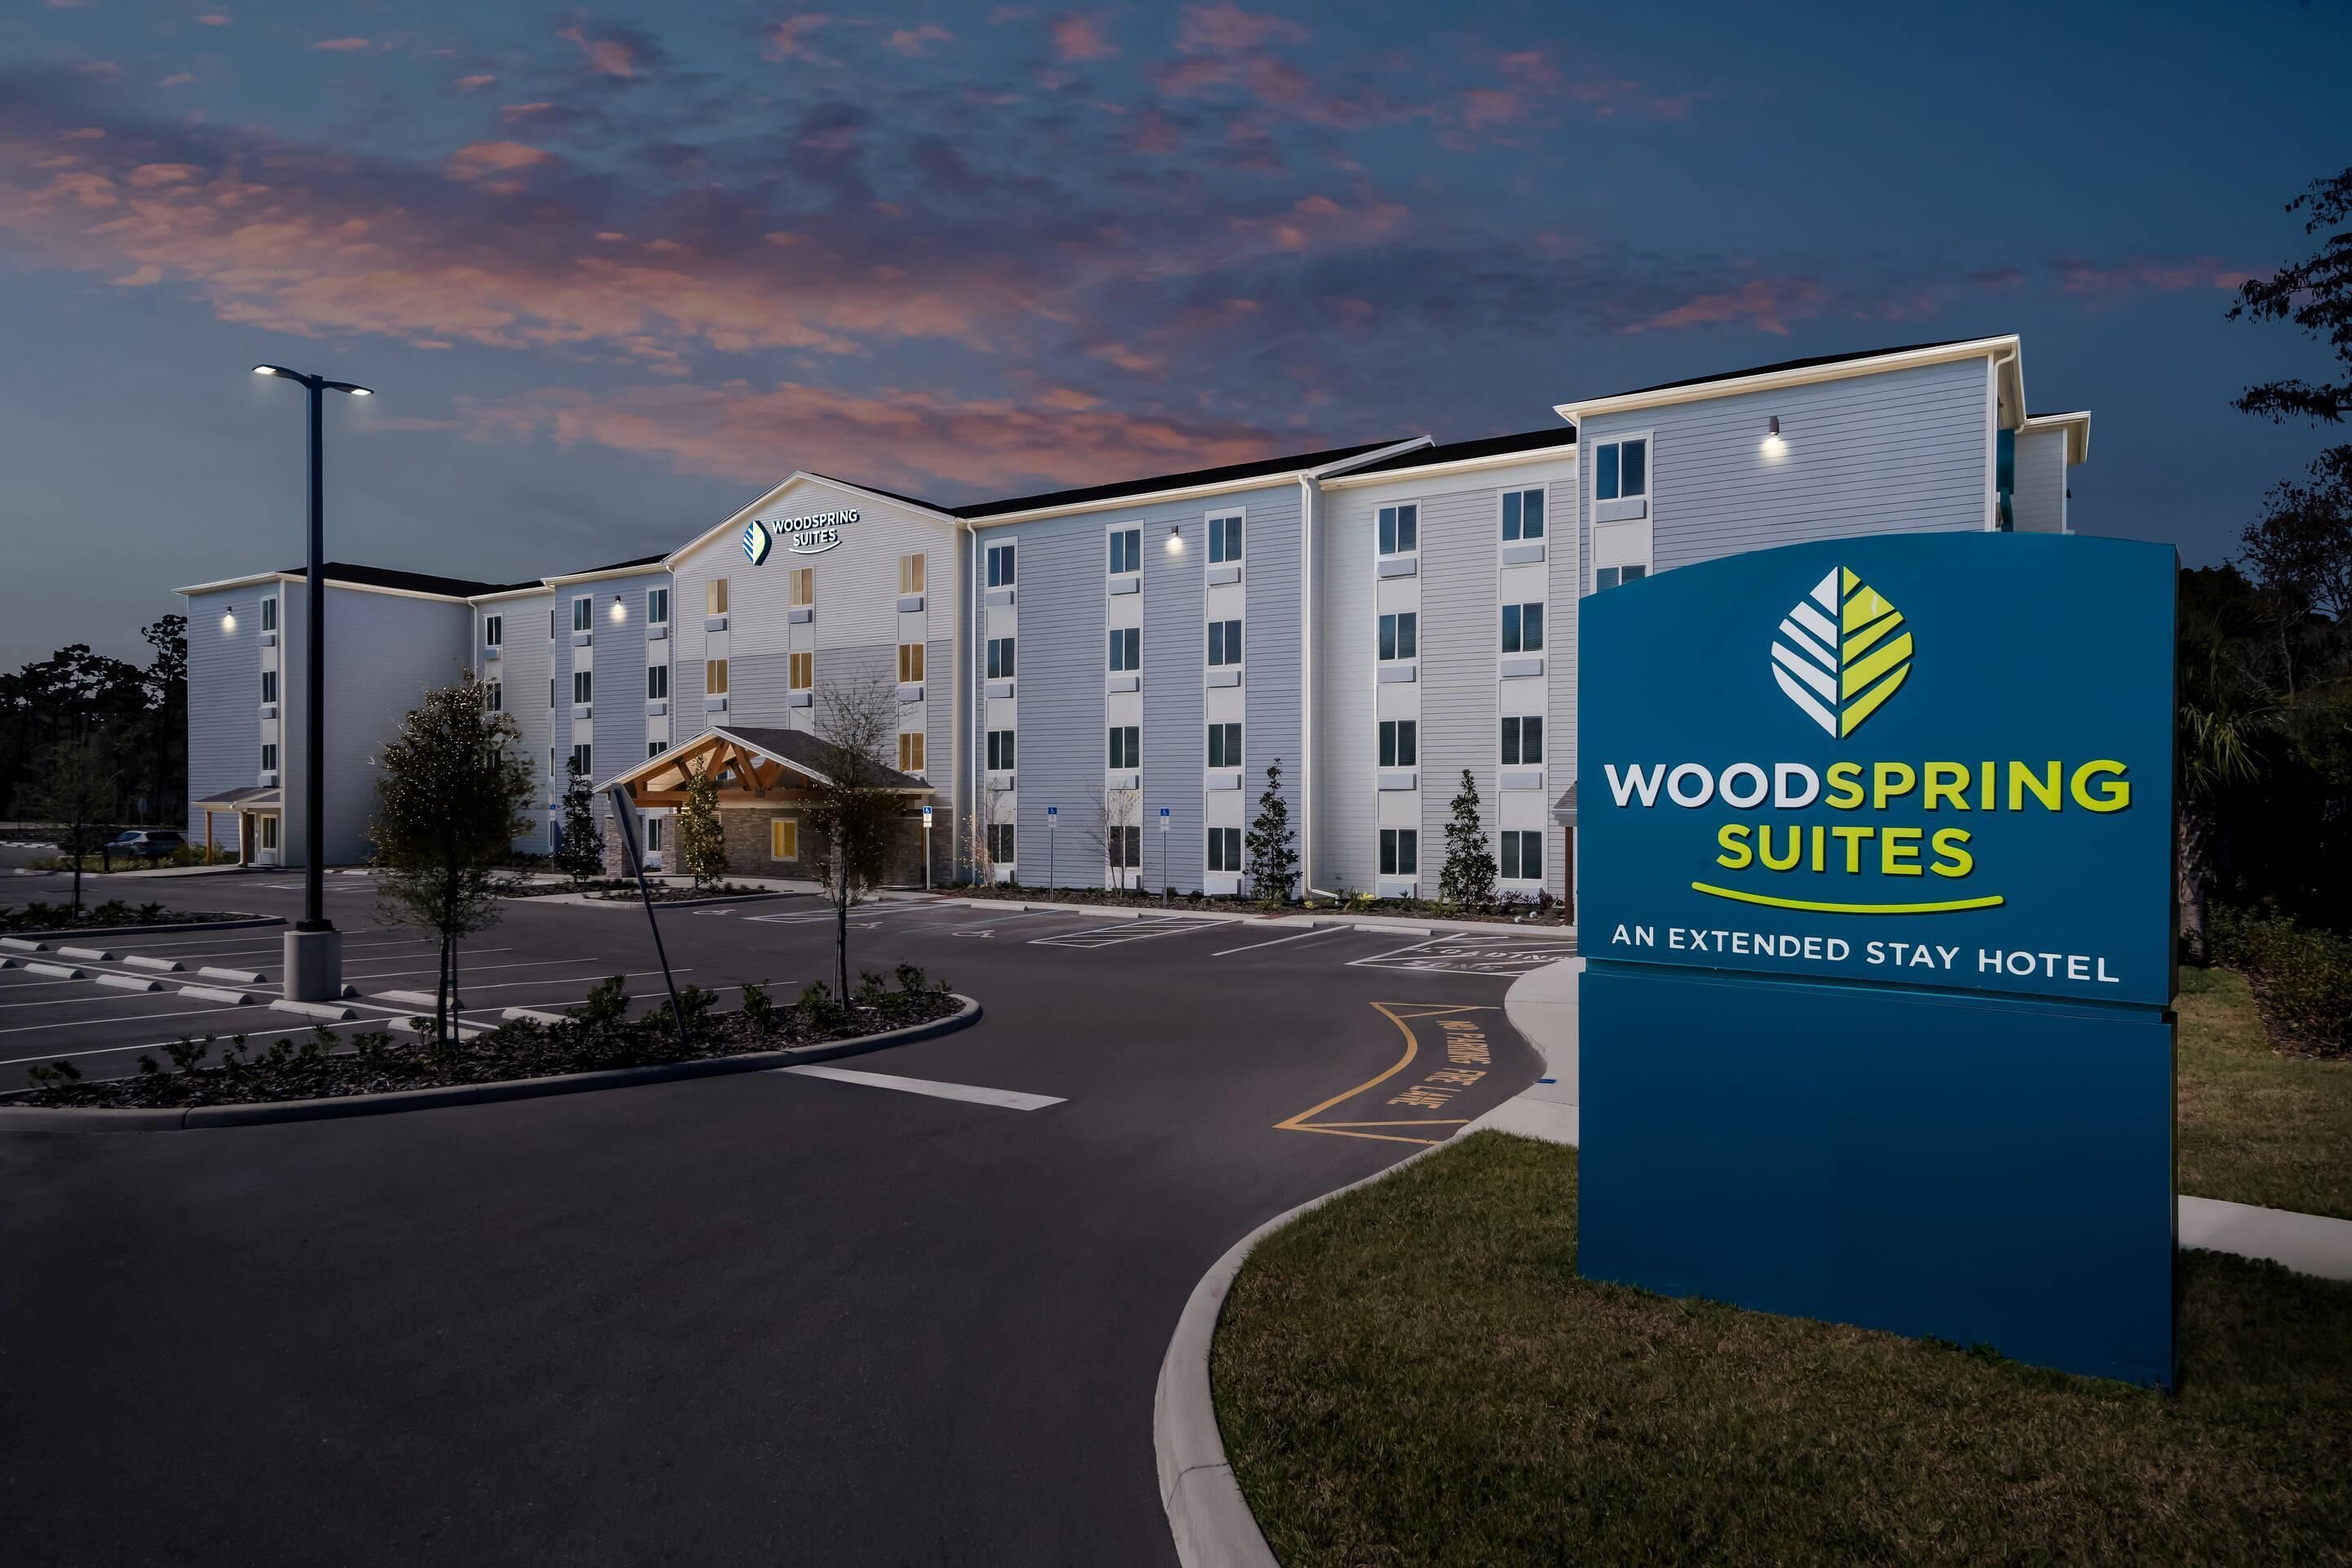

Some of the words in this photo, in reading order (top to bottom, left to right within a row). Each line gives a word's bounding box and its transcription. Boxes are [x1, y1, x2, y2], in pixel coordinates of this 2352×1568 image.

[772, 510, 858, 534] WOODSPRING
[793, 528, 837, 547] SUITES
[1604, 760, 2130, 812] WOODSPRING
[1716, 823, 1973, 877] SUITES
[1611, 924, 1654, 947] AN
[1669, 928, 1850, 961] EXTENDED
[1866, 941, 1960, 969] STAY
[1979, 948, 2119, 982] HOTEL
[1402, 960, 1503, 971] ZONE
[1436, 1020, 1479, 1031] NO
[1446, 1032, 1491, 1064] PARKING
[1424, 1067, 1487, 1086] FIRE
[1386, 1085, 1463, 1108] LANE
